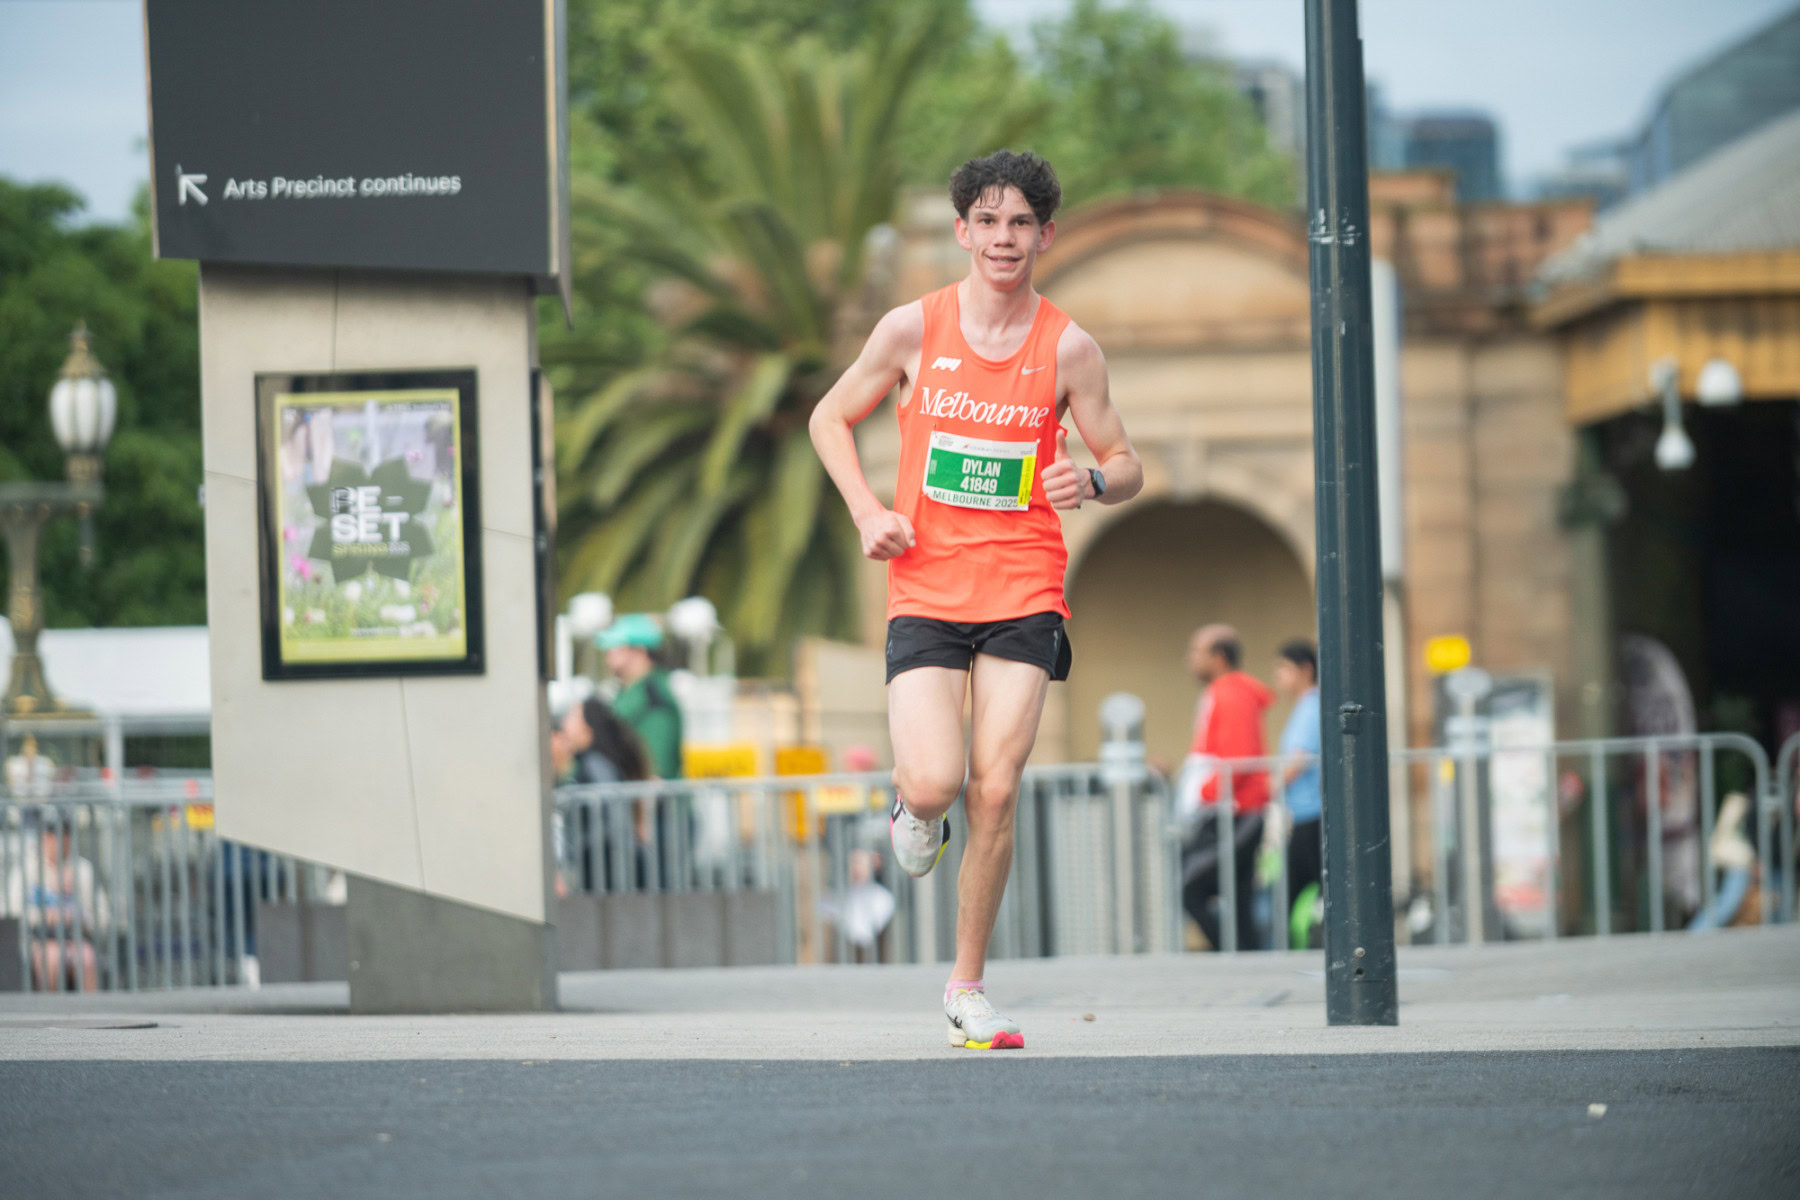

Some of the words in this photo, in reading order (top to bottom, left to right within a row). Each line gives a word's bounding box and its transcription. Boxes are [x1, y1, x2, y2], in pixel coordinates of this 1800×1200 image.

[223, 177, 268, 199] Arts
[271, 174, 357, 199] Precinct
[360, 172, 462, 198] continues
[920, 386, 1050, 428] Melbourne
[961, 458, 1002, 478] DYLAN
[960, 476, 998, 494] 41849
[932, 490, 992, 507] MELBOURNE
[332, 512, 410, 542] SET
